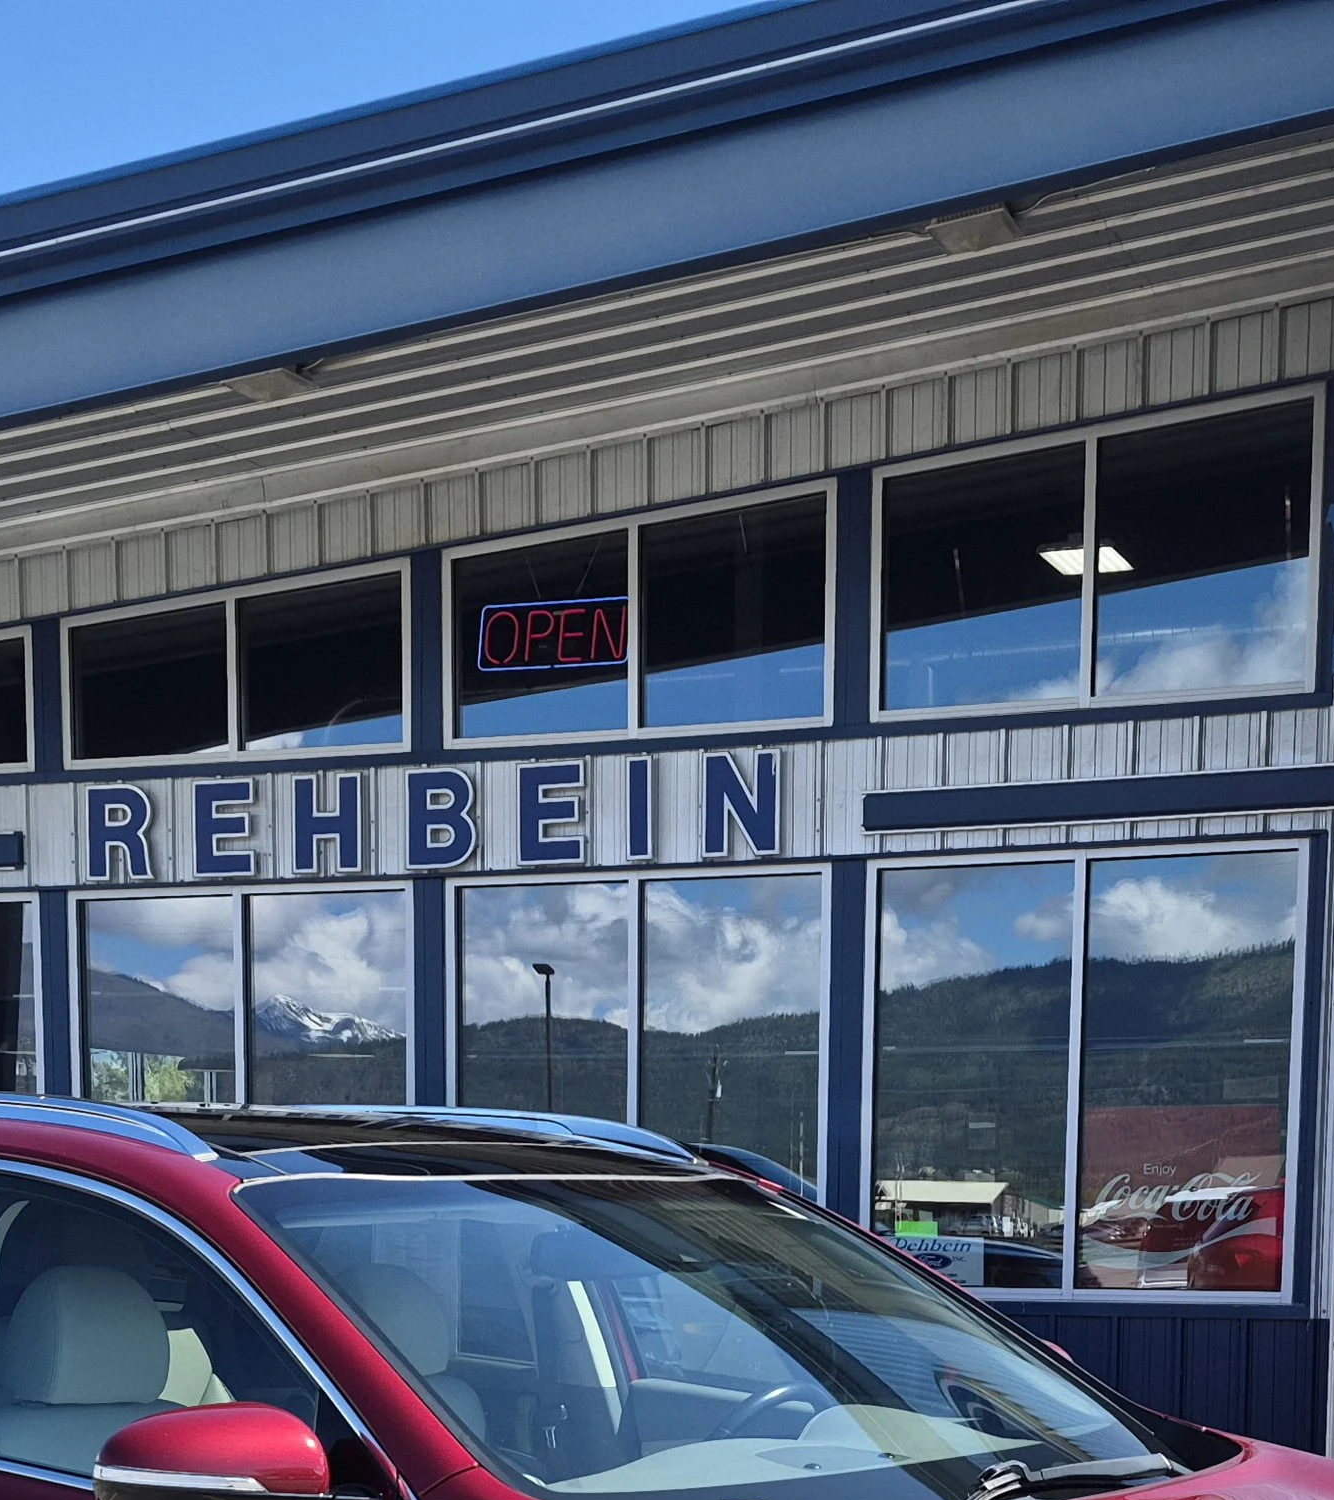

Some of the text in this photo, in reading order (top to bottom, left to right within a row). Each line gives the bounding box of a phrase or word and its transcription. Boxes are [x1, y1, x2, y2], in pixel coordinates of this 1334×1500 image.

[483, 607, 628, 665] OPEN
[84, 747, 784, 881] REHBEIN
[1142, 1163, 1177, 1176] Enjoy
[1094, 1172, 1261, 1222] Coca-Cola
